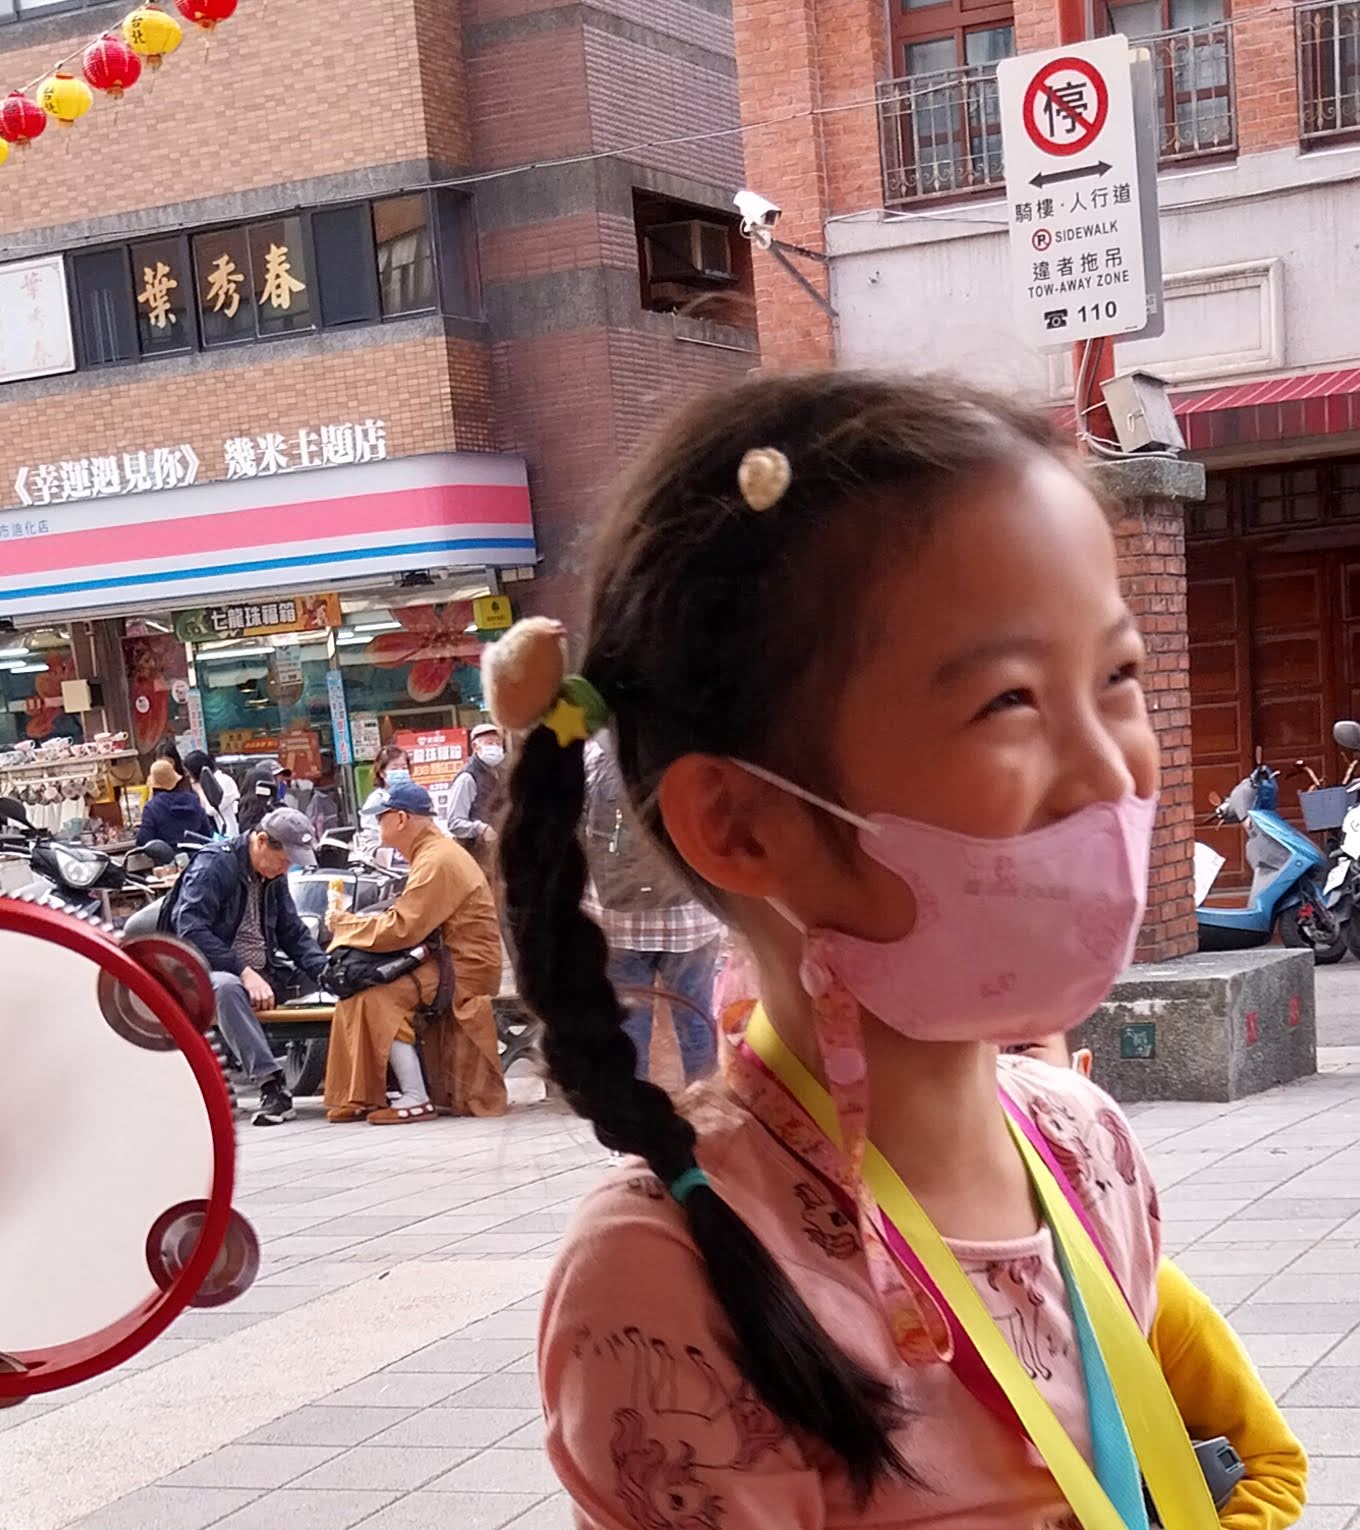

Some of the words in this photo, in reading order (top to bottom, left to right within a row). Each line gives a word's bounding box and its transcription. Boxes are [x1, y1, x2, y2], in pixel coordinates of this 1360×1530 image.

[1055, 220, 1118, 243] SIDEWALK
[1032, 248, 1123, 282] 違者拖吊
[1028, 277, 1092, 299] TOW-AWAY
[1097, 270, 1129, 287] ZONE
[1078, 301, 1117, 323] 110
